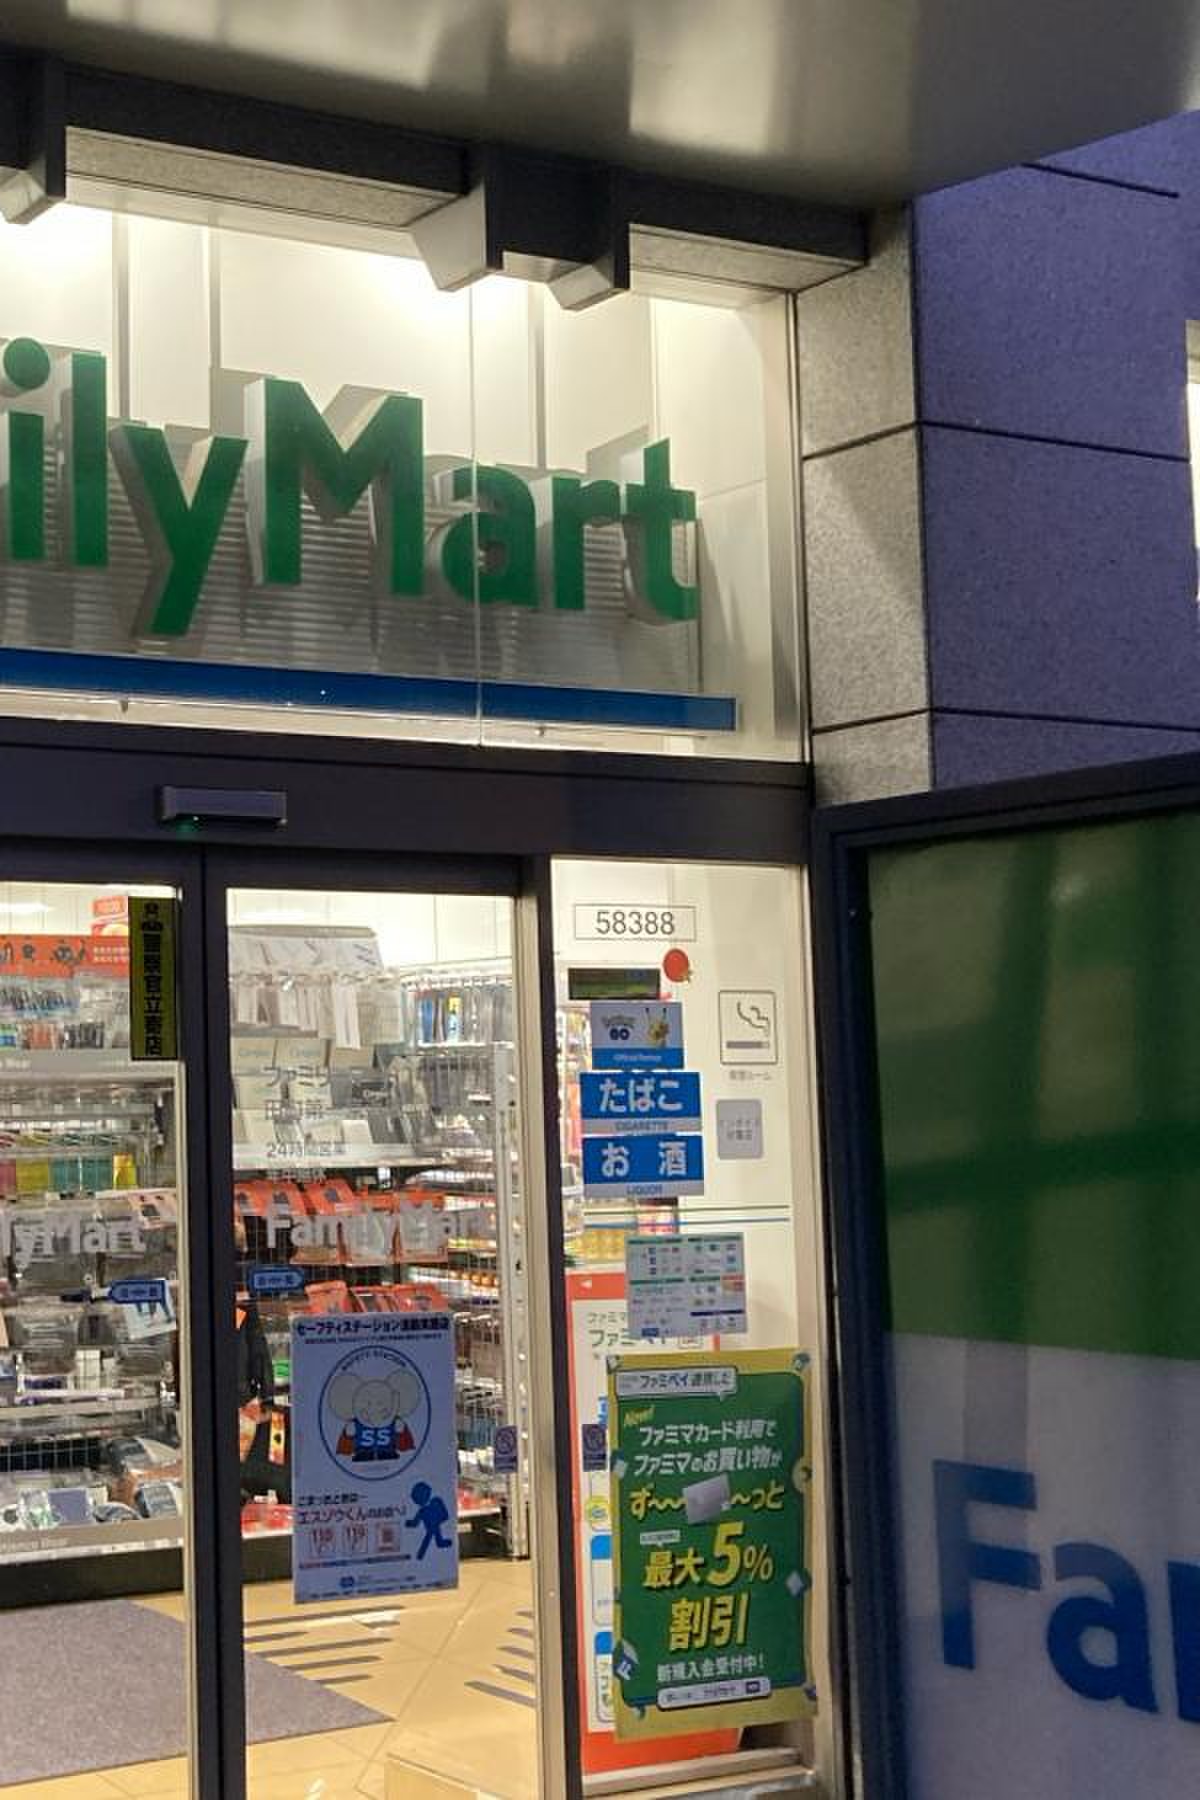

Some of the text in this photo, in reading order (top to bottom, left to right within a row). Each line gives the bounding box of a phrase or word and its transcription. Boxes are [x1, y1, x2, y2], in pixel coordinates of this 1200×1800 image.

[596, 910, 675, 936] 58388
[600, 1077, 683, 1113] たばこ
[360, 1429, 392, 1446] SS
[933, 1459, 1200, 1724] Fa
[669, 1593, 749, 1651] 割引
